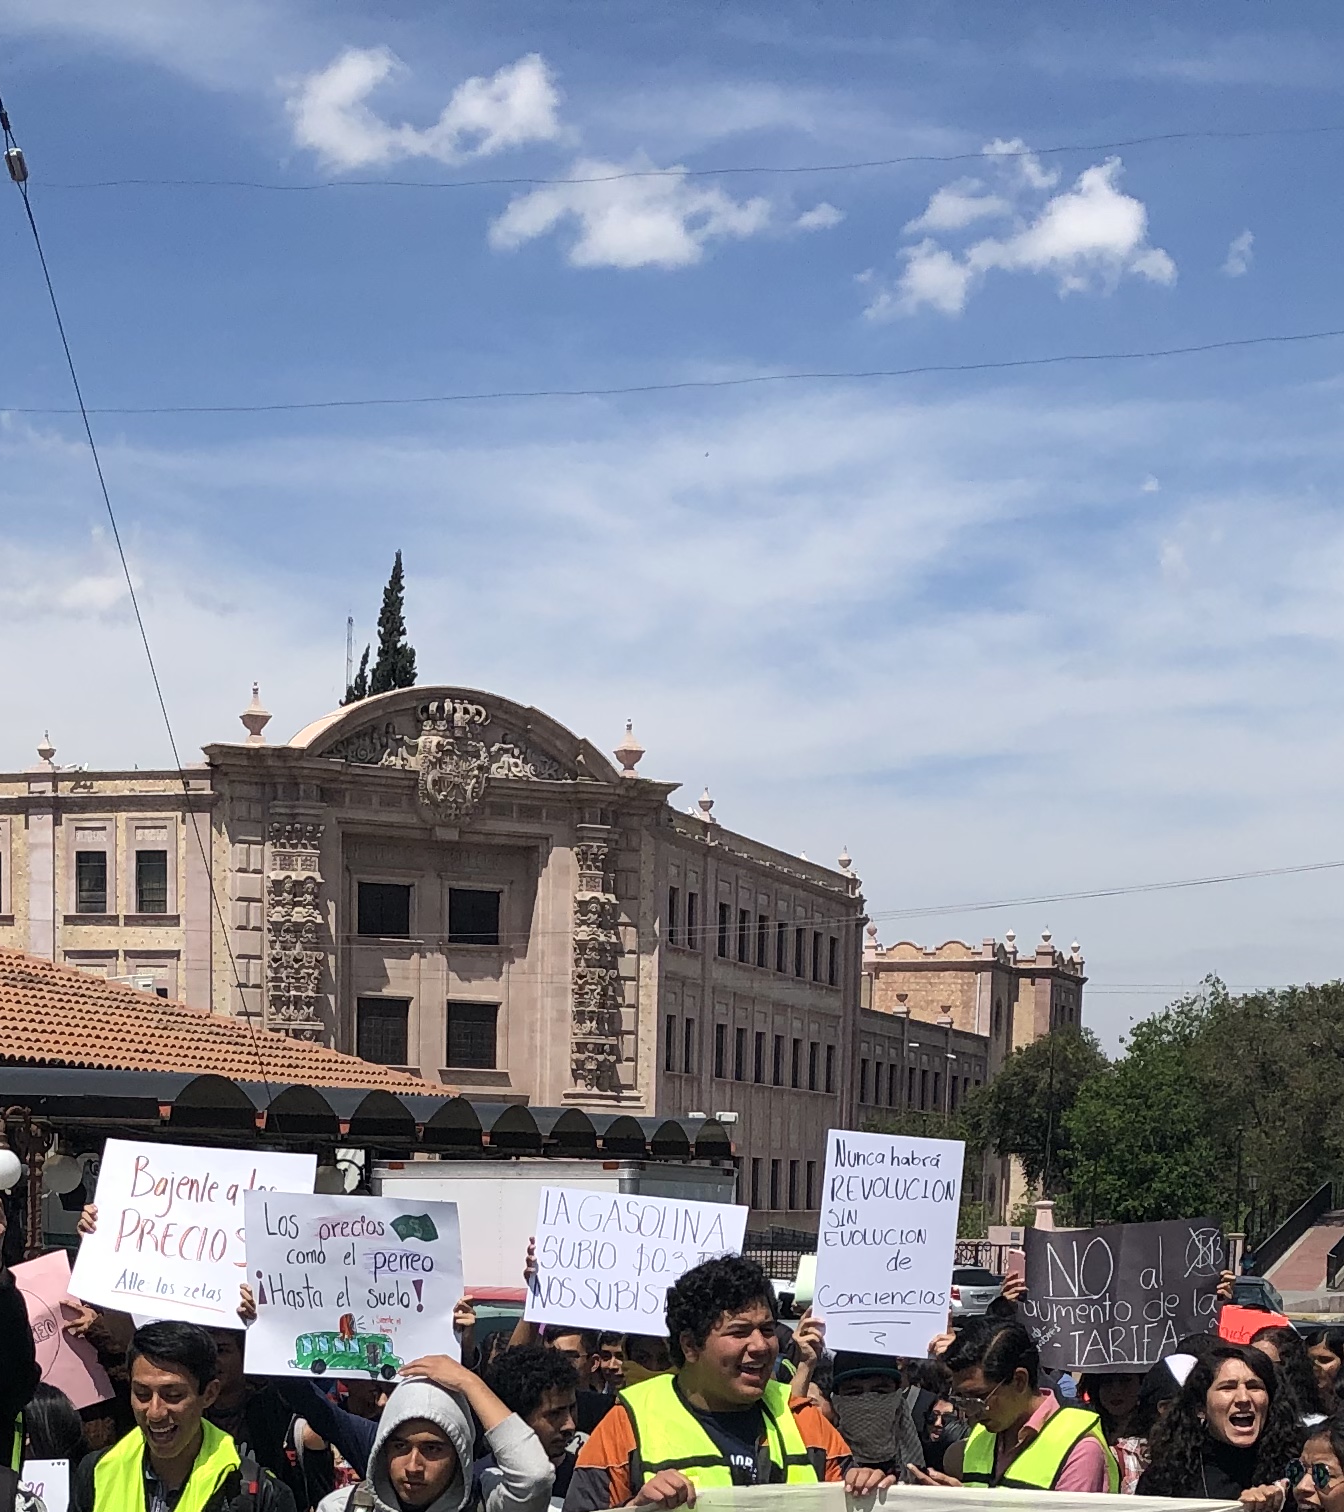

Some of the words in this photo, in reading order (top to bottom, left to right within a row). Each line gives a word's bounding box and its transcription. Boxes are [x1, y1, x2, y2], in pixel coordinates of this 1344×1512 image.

[834, 1137, 885, 1169] Nunca
[890, 1145, 942, 1169] habrá
[225, 1182, 240, 1207] a
[830, 1174, 956, 1203] REVOLUCION
[263, 1201, 300, 1240] Los
[318, 1215, 386, 1252] precios
[542, 1189, 570, 1227] LA
[577, 1194, 725, 1250] GASOLINA
[827, 1208, 858, 1229] SIN
[540, 1235, 617, 1271] SUBIO
[823, 1228, 928, 1247] EVOLUCION
[286, 1248, 327, 1265] como
[343, 1242, 356, 1266] el
[373, 1250, 434, 1284] perreo
[886, 1249, 913, 1272] de
[1046, 1236, 1114, 1298] NO
[1140, 1235, 1164, 1290] al
[155, 1276, 175, 1296] los
[256, 1270, 324, 1311] ¡Hasta
[336, 1275, 351, 1308] el
[366, 1278, 425, 1313] suelo!
[531, 1275, 577, 1310] NOS
[817, 1284, 946, 1307] Conciencias
[1023, 1292, 1133, 1325] aumento
[1142, 1291, 1181, 1321] de
[1193, 1288, 1218, 1317] la
